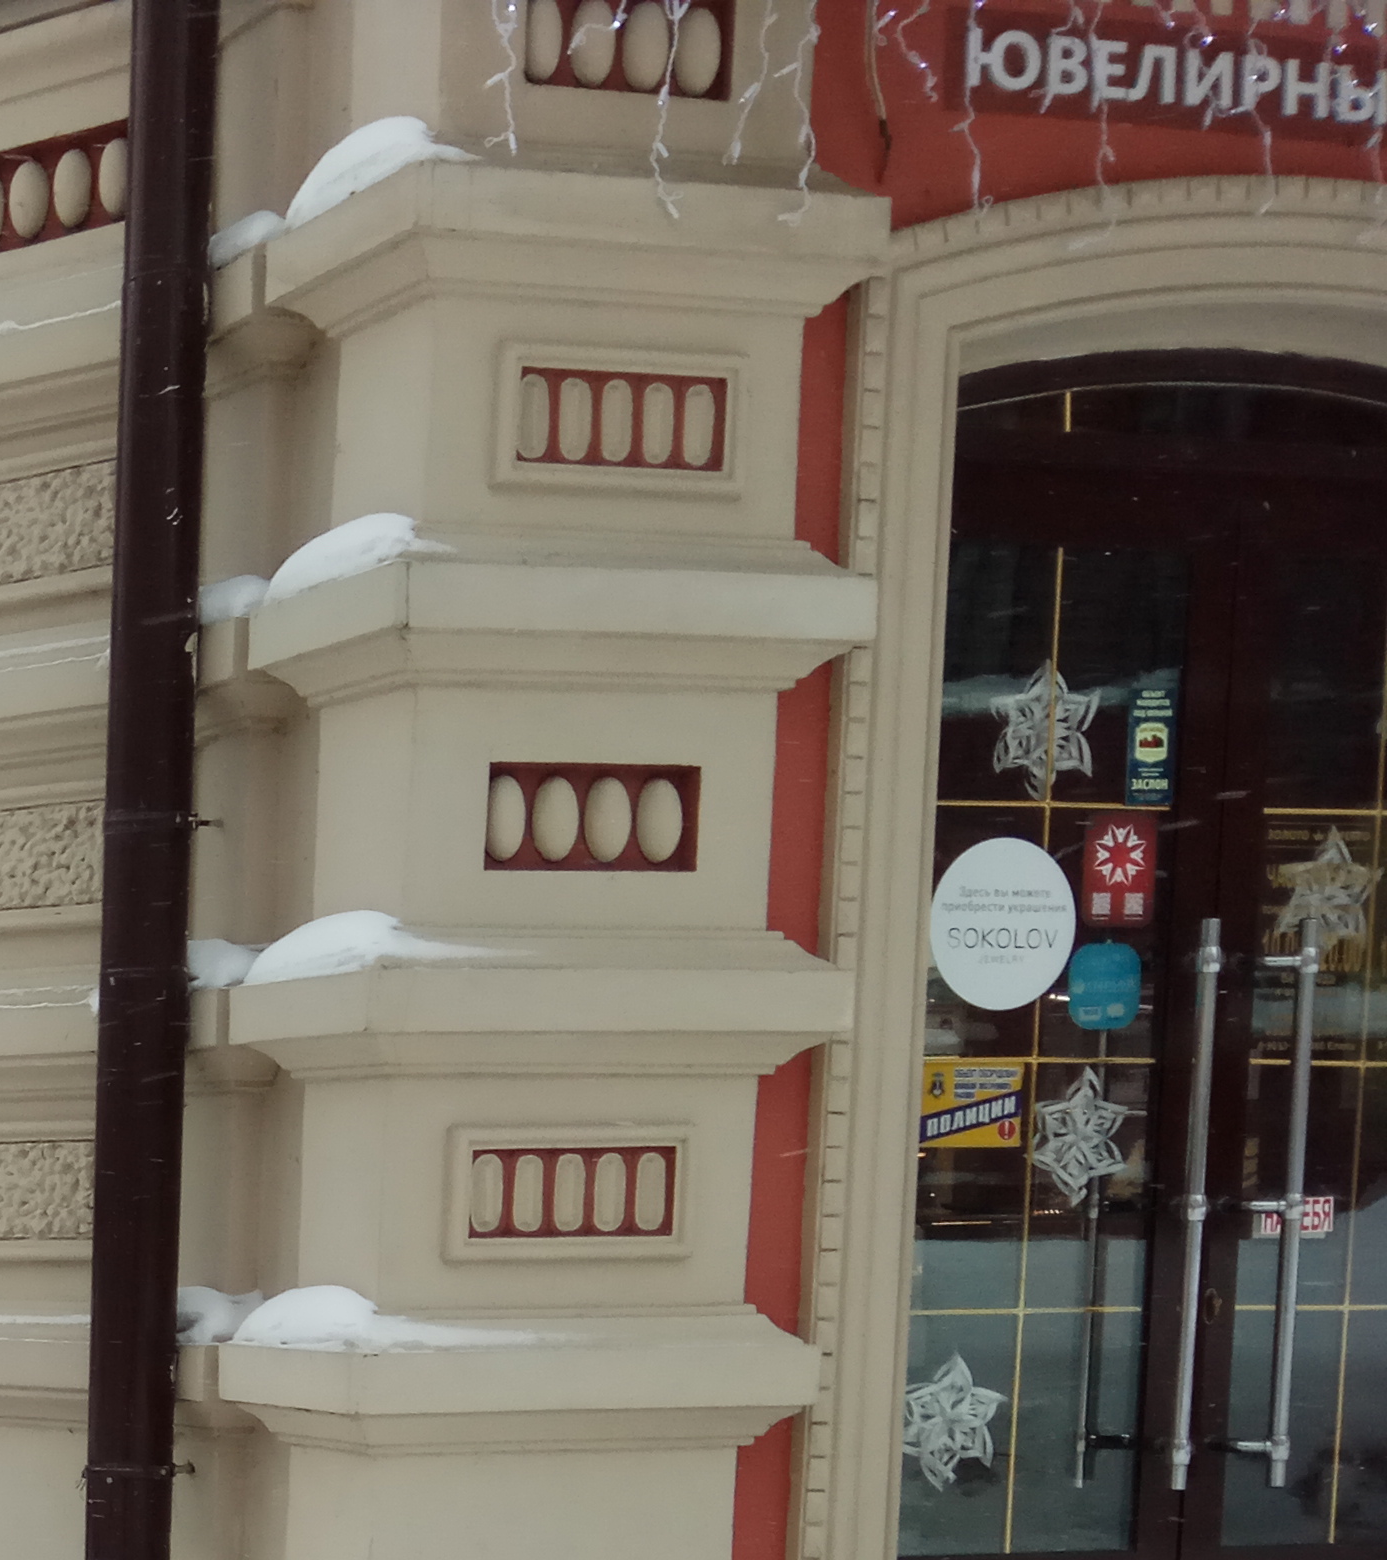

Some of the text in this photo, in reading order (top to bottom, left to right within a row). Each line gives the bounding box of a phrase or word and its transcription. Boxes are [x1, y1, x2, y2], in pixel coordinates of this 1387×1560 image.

[959, 886, 1051, 898] Здесь вы можете
[941, 901, 1068, 914] приобрести украшения
[947, 927, 1058, 949] SOKOLOV
[926, 1096, 1016, 1137] ПОЛИЦИИ
